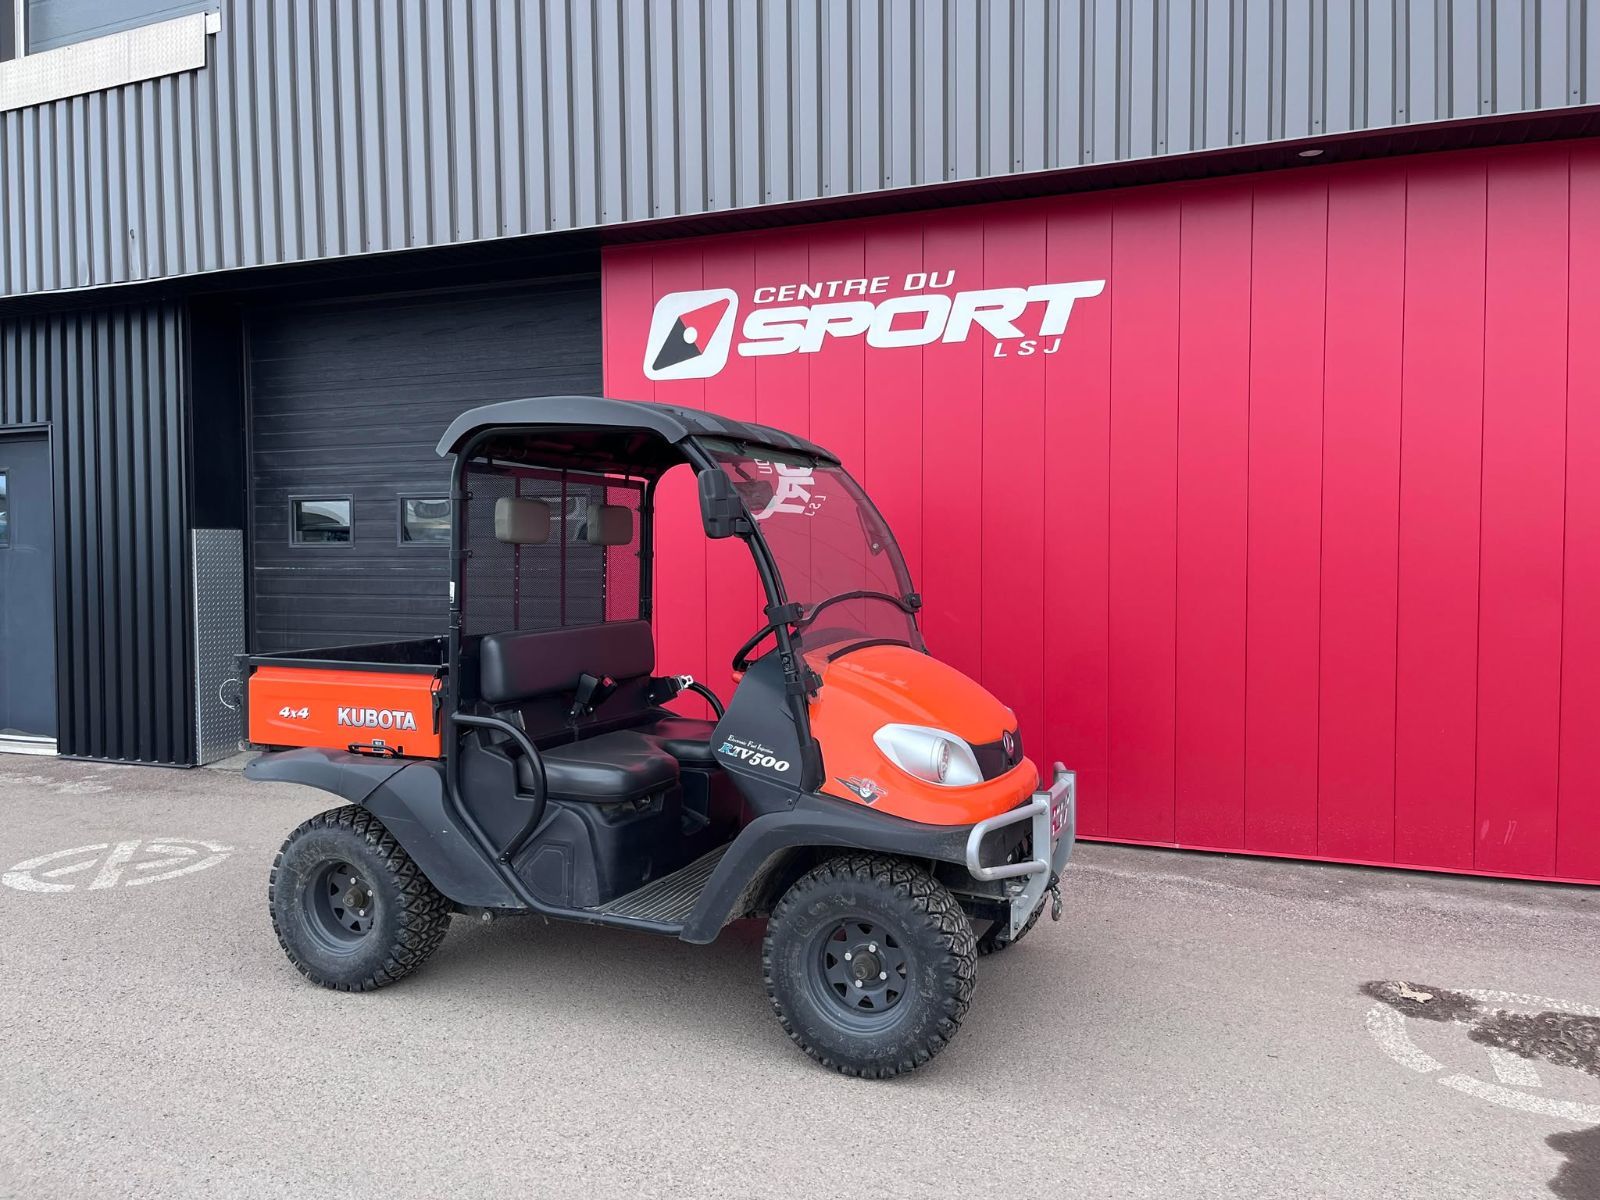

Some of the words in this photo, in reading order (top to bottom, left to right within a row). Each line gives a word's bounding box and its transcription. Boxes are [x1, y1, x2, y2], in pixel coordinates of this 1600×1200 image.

[753, 277, 890, 304] CENTRE
[903, 269, 956, 291] DU
[737, 279, 1106, 357] SPORT
[993, 338, 1062, 358] LSJ
[278, 706, 310, 719] 4x4
[337, 707, 417, 731] KUBOTA
